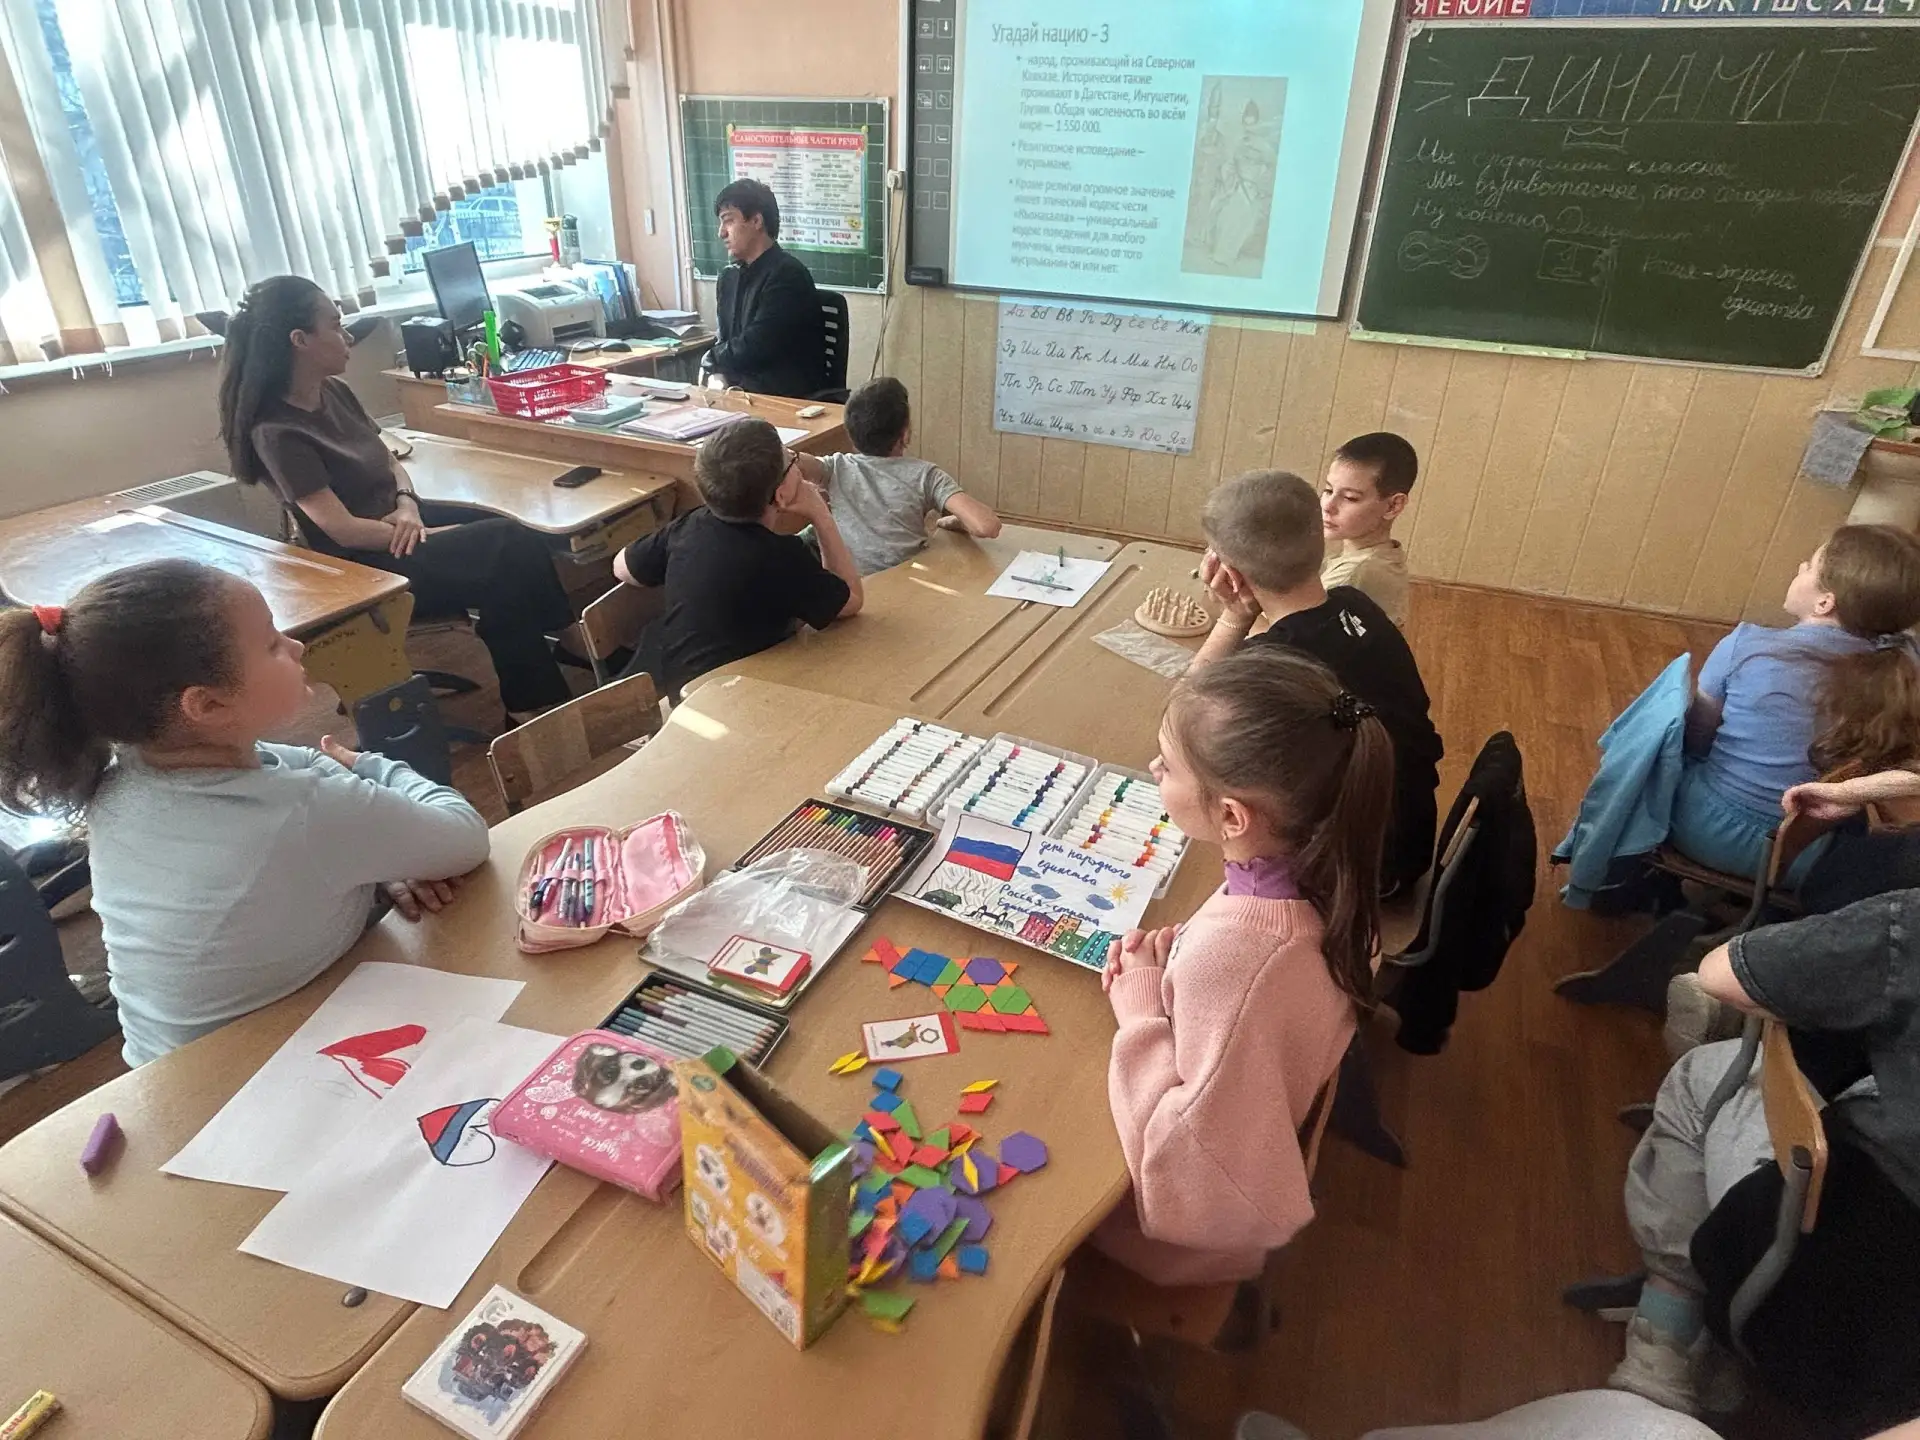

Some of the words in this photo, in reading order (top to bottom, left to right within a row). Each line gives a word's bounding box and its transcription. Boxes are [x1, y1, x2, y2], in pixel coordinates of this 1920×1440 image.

[991, 21, 1038, 46] Угадай
[1042, 28, 1088, 47] нацию
[1099, 23, 1110, 43] 3
[1027, 55, 1058, 69] народ,
[1060, 54, 1130, 70] проживающий
[1131, 57, 1144, 68] на
[1145, 55, 1196, 71] Северном
[1062, 71, 1121, 86] Исторически
[1123, 73, 1153, 84] также
[1467, 47, 1877, 122] ДИНАМИТ
[1081, 88, 1132, 104] Дагестане,
[1133, 89, 1189, 106] Ингушетии,
[1054, 103, 1085, 119] Общая
[1087, 107, 1146, 119] численность
[1147, 109, 1160, 119] во
[1161, 106, 1186, 120] всём
[734, 134, 809, 145] САМОСТОЯТЕЛЬНЫЕ
[810, 135, 838, 145] ЧАСТИ
[838, 137, 858, 146] РЕЧИ
[1076, 144, 1137, 157] исповедание
[1045, 181, 1082, 194] религии
[1083, 182, 1129, 197] огромное
[1130, 185, 1177, 198] значение
[1042, 194, 1087, 208] этический
[1089, 199, 1120, 211] кодекс
[1121, 201, 1148, 212] чести
[797, 215, 821, 225] ЧАСТИ
[821, 218, 841, 228] РЕЧИ
[1012, 226, 1041, 238] кодекс
[1042, 228, 1091, 241] поведения
[1092, 231, 1110, 242] для
[1111, 232, 1146, 245] любого
[1110, 249, 1121, 259] от
[1122, 249, 1143, 260] того
[1069, 260, 1081, 270] он
[1082, 262, 1099, 273] или
[1030, 304, 1051, 320] Бб
[1055, 306, 1073, 322] Вв
[1079, 309, 1095, 325] Гг
[1100, 312, 1122, 332] Дд
[1175, 318, 1204, 335] Жж
[1002, 338, 1017, 357] Зз
[1020, 341, 1041, 356] Ии
[1045, 340, 1066, 359] Йй
[1070, 345, 1093, 362] Кк
[1096, 348, 1119, 364] Лл
[1121, 353, 1150, 368] Мм
[1153, 354, 1177, 371] Нн
[1181, 357, 1198, 373] Оо
[1000, 372, 1022, 389] Пп
[1026, 375, 1043, 395] Рр
[1047, 377, 1063, 393] Сс
[1066, 380, 1097, 397] Тт
[1099, 384, 1117, 404] Уу
[1120, 386, 1142, 407] Фф
[1145, 390, 1168, 406] Хх
[1171, 393, 1193, 411] Цц
[1020, 411, 1045, 427] Шш
[1049, 415, 1075, 432] Щщ
[1140, 427, 1162, 442] Юю
[1166, 430, 1189, 445] Яя
[1039, 839, 1066, 857] день
[1068, 848, 1132, 879] народного
[1037, 859, 1097, 887] единства
